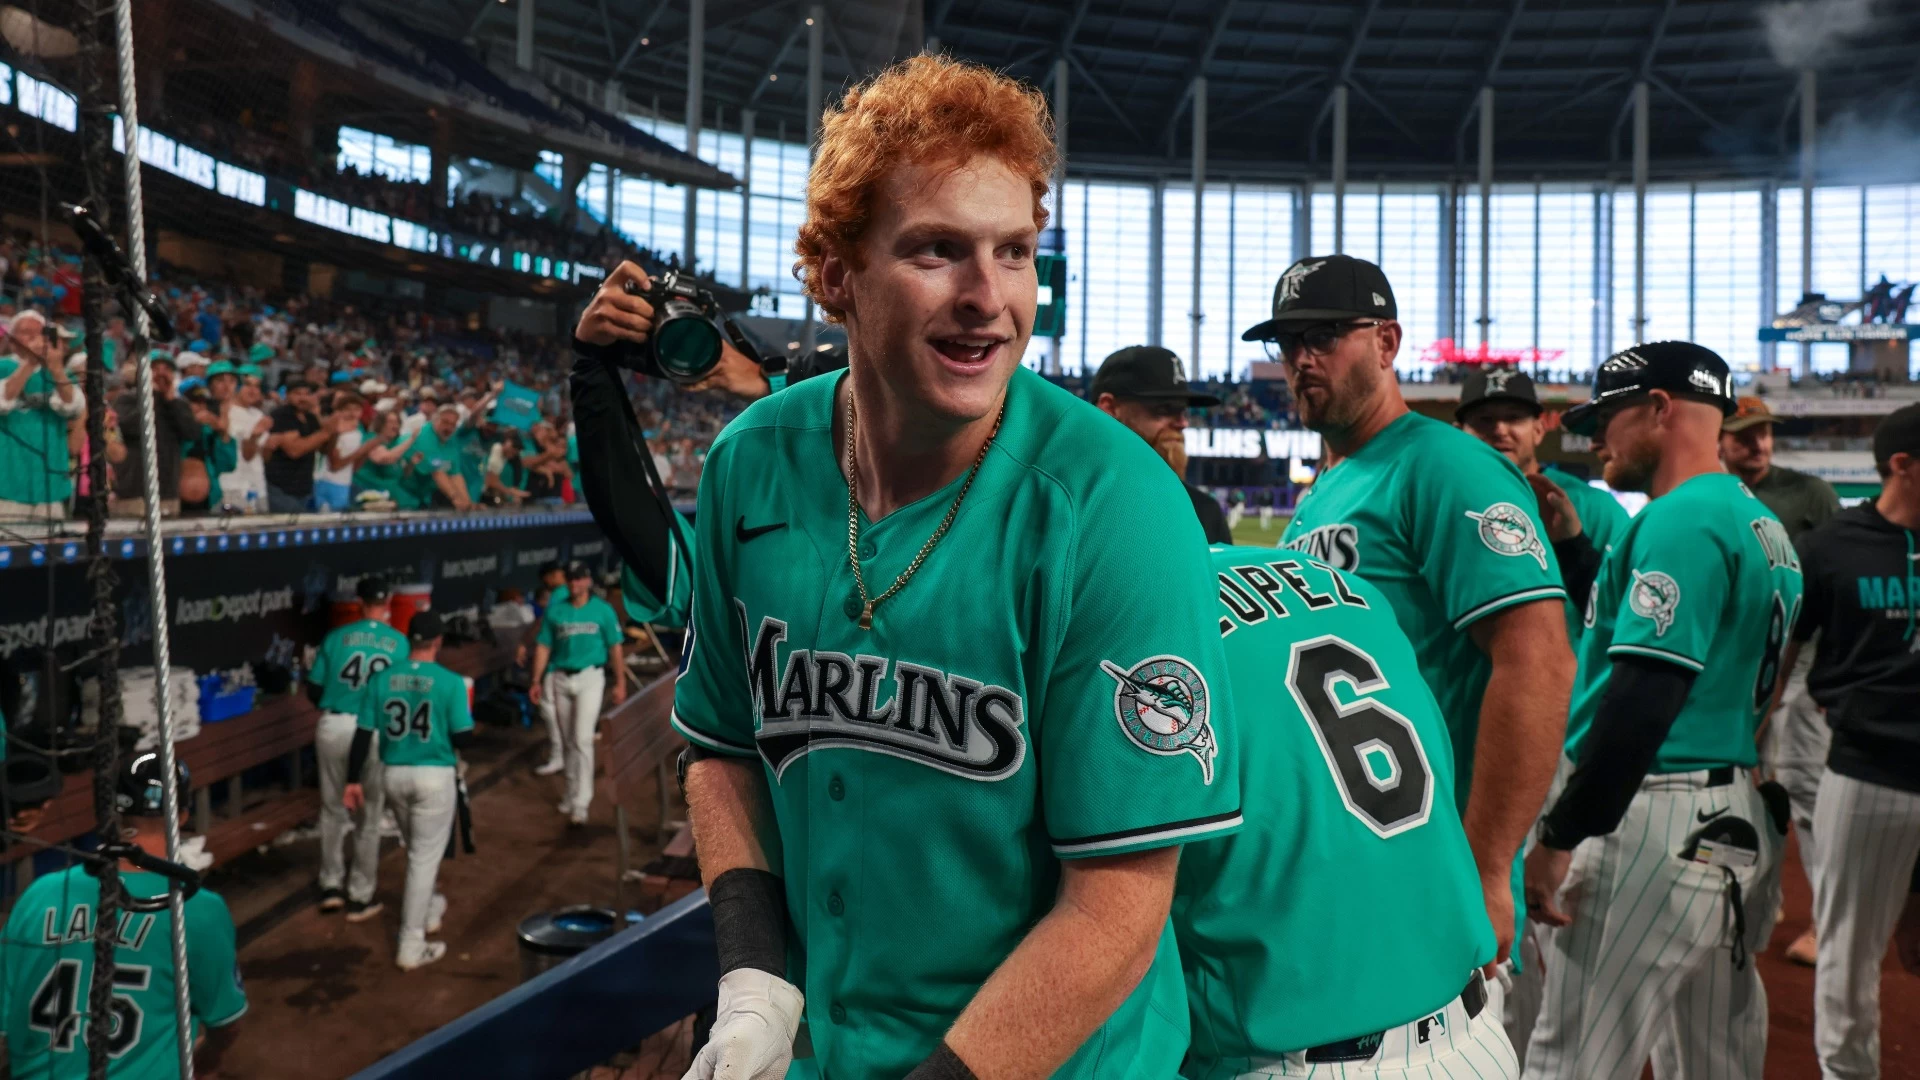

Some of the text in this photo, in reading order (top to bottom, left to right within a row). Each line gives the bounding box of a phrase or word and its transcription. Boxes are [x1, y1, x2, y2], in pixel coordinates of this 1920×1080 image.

[216, 160, 266, 207] WIN
[295, 188, 391, 243] MARLINS
[1264, 430, 1322, 459] WIN
[1218, 558, 1371, 639] OPEZ
[735, 597, 1025, 783] MARLINS
[1138, 660, 1205, 713] FLORIDA
[383, 697, 432, 743] 34
[1123, 708, 1200, 749] MARLINS
[1286, 634, 1434, 839] 6
[42, 903, 156, 951] LALI
